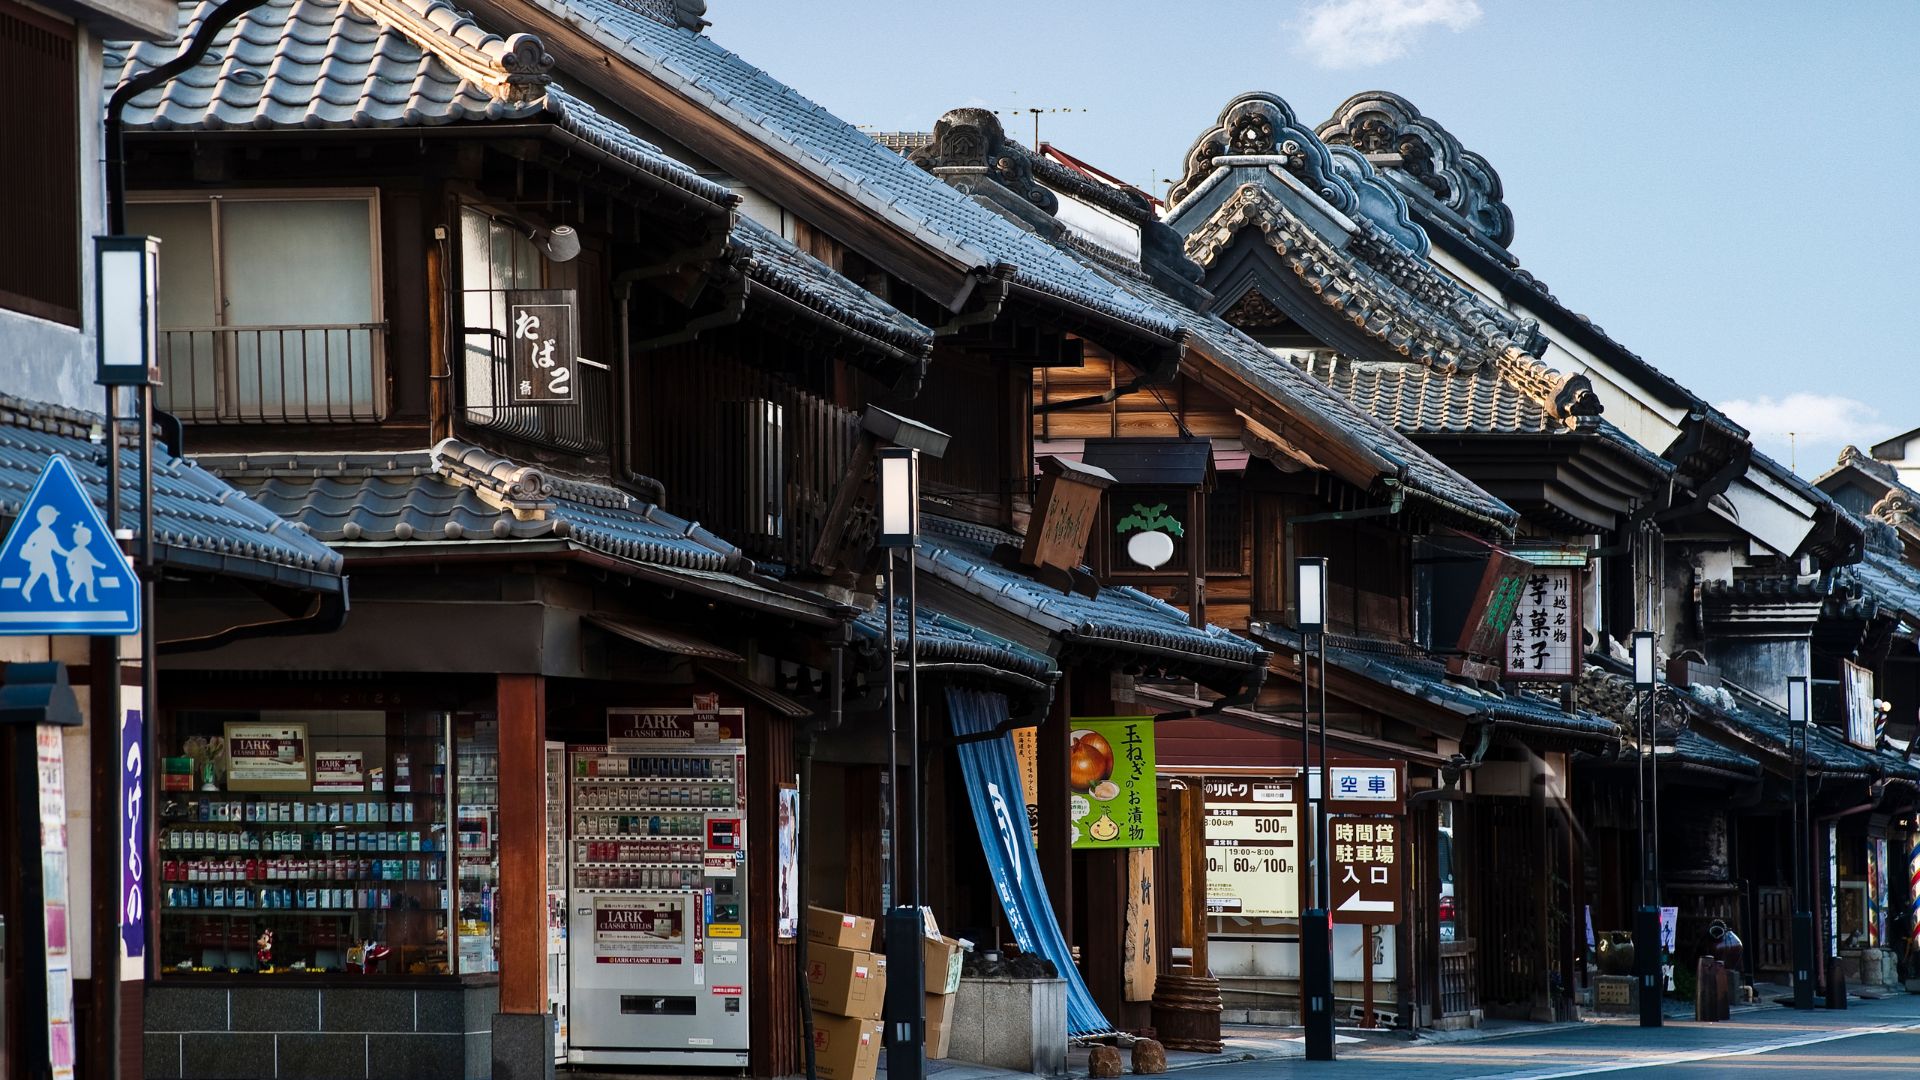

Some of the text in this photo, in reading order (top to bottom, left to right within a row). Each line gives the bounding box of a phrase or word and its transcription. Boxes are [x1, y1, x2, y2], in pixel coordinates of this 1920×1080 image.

[515, 310, 570, 394] たばこ
[1553, 577, 1567, 643] 川越名物
[1527, 574, 1550, 670] 芋菓子
[634, 715, 679, 729] LARK
[624, 729, 690, 738] CLASSIC MILDS
[240, 740, 270, 750] LARK
[1121, 723, 1146, 841] 玉ねぎのお漬物
[1204, 783, 1247, 796] のリパーク
[1341, 776, 1386, 794] 空車
[126, 741, 142, 925] つけもの
[1255, 819, 1287, 833] 500円
[1336, 824, 1394, 843] 時間貸
[1336, 845, 1394, 863] 駐車場
[1342, 866, 1388, 884] 入口
[608, 911, 643, 922] LARK
